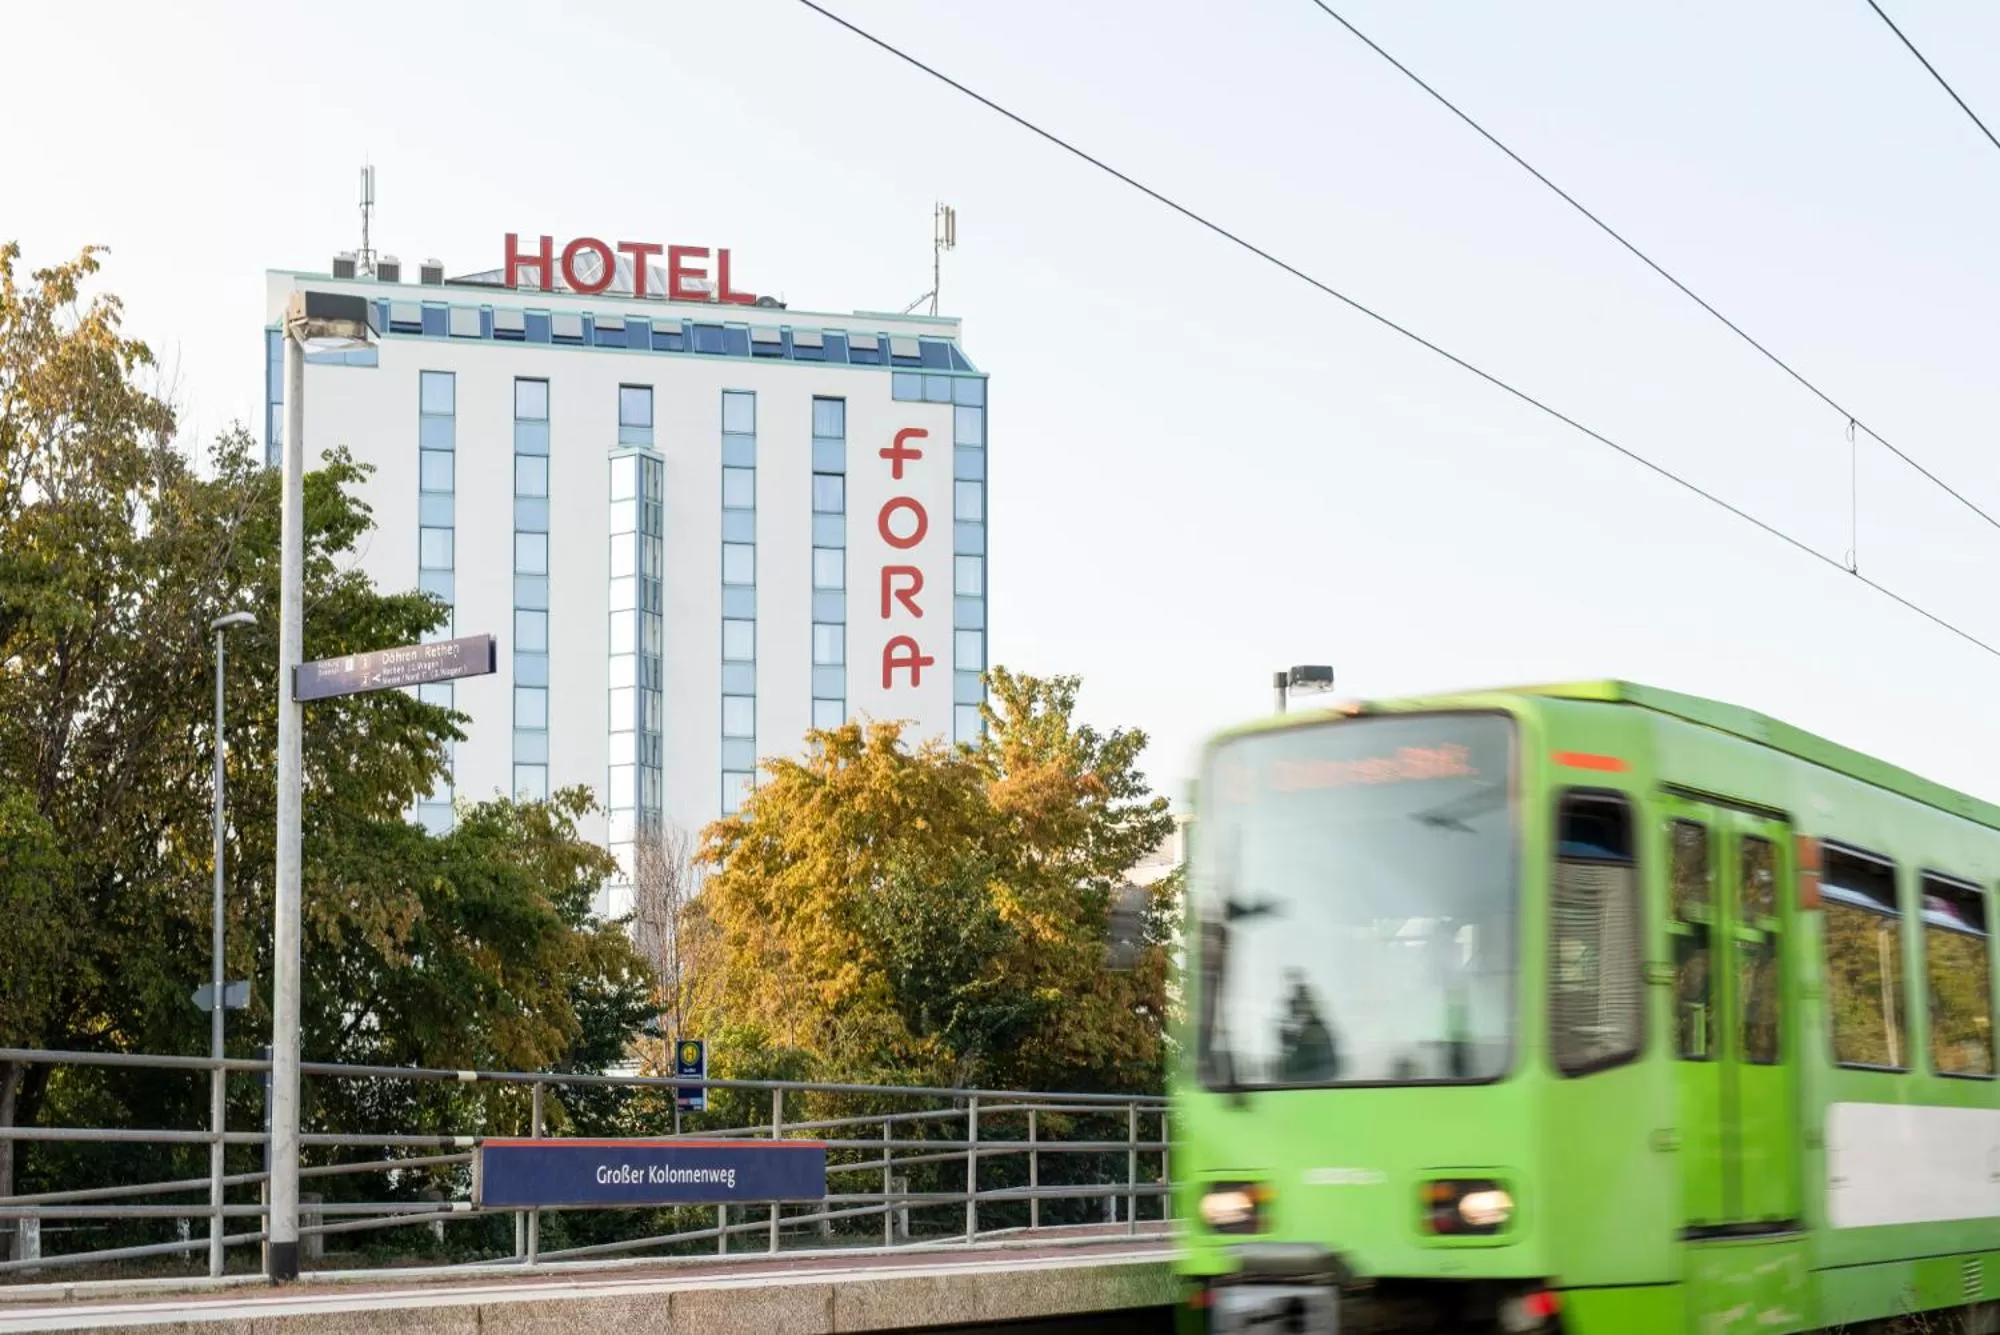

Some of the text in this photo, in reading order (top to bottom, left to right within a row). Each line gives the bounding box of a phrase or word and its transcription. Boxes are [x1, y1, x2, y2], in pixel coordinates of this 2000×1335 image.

[504, 233, 757, 304] HOTEL
[596, 1164, 736, 1189] Großer Kolonnenweg
